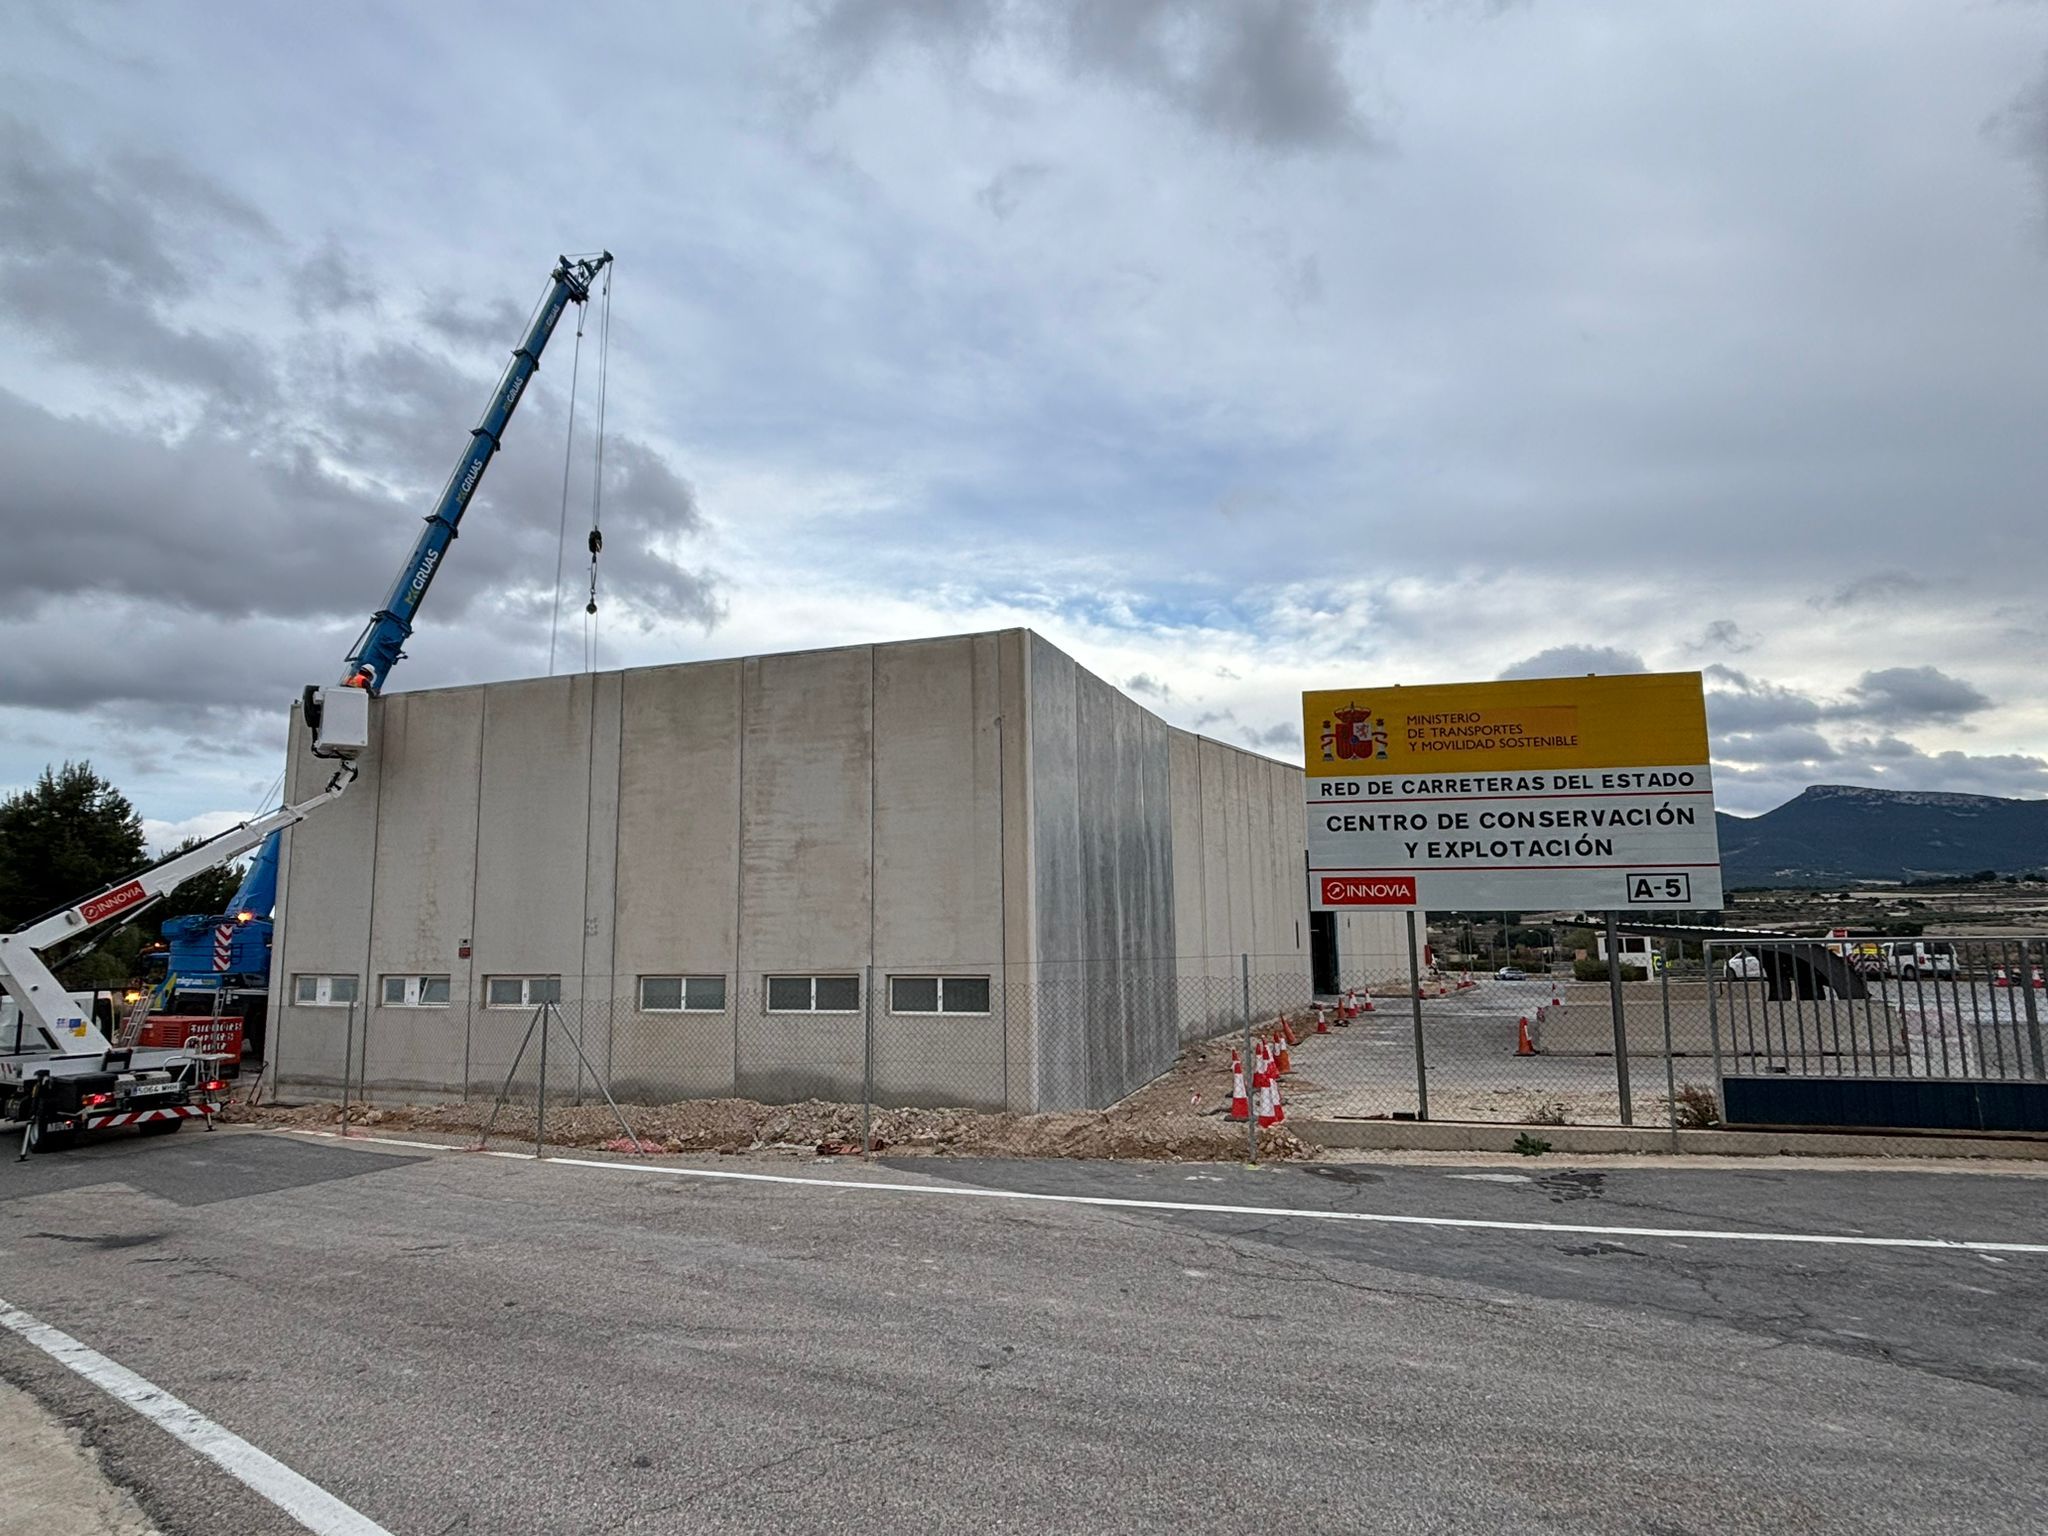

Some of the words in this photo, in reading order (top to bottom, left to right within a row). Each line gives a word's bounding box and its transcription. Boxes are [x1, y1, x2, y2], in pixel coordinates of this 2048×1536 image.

[1407, 712, 1481, 726] MINISTERIO
[1407, 728, 1425, 739] DE
[1431, 724, 1523, 737] TRANSPORTES
[1409, 742, 1417, 752] Y
[1421, 738, 1496, 751] MOVILIDAD
[1499, 735, 1578, 748] SOSTENIBLE
[1321, 782, 1360, 796] RED
[1368, 781, 1394, 795] DE
[1401, 776, 1545, 794] CARRETERAS
[1553, 775, 1594, 790] DEL
[1602, 772, 1695, 789] ESTADO
[1326, 813, 1428, 832] CENTRO
[1438, 813, 1470, 830] DE
[1479, 802, 1695, 829] CONSERVACIÓN
[1405, 842, 1419, 858] Y
[1427, 833, 1613, 858] EXPLOTACIÓN
[1346, 884, 1411, 897] INNOVIA
[1634, 878, 1682, 898] A-5
[97, 887, 143, 912] INNOVIA
